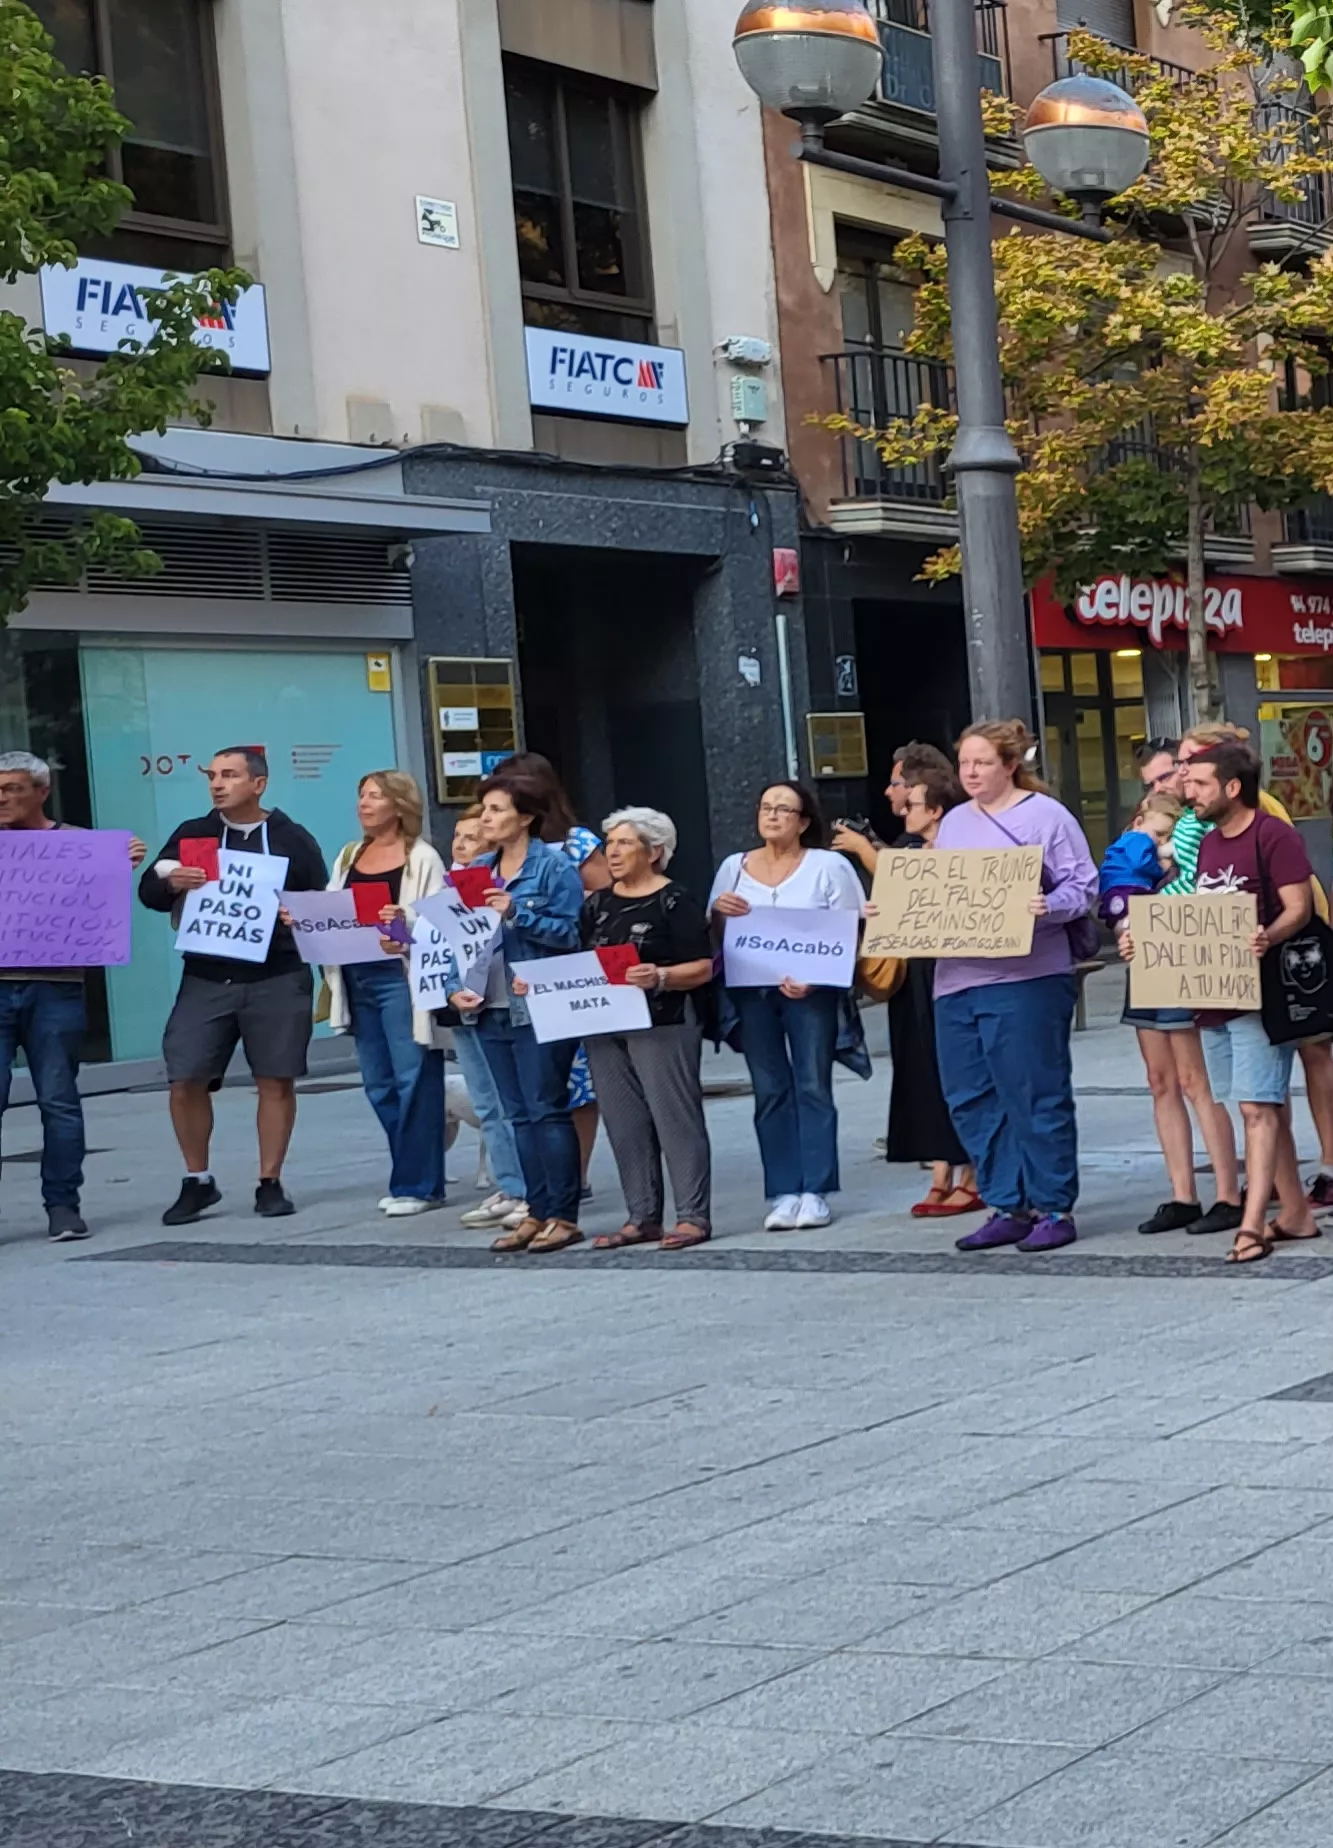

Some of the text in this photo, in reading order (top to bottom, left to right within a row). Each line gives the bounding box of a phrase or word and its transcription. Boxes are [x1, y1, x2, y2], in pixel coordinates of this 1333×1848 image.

[75, 316, 236, 348] SEGOS
[549, 346, 634, 386] FIATC
[549, 379, 665, 404] SEGUROS
[1076, 573, 1244, 643] telepiza
[1307, 595, 1330, 615] 974
[227, 863, 254, 879] NI
[890, 855, 939, 881] POR
[947, 855, 968, 880] EL
[218, 880, 254, 899] UN
[906, 887, 941, 912] DEL
[198, 898, 262, 921] PASO
[897, 910, 1006, 933] FEMINISMO
[186, 918, 265, 944] ATRÁS
[460, 915, 492, 936] UN
[735, 934, 844, 957] #SeAcabó
[1142, 940, 1188, 970] DALE
[1193, 943, 1213, 966] UN
[421, 947, 453, 971] PAS
[533, 983, 552, 996] EL
[1179, 973, 1192, 999] A
[1193, 973, 1213, 997] TU
[569, 996, 611, 1012] MATA
